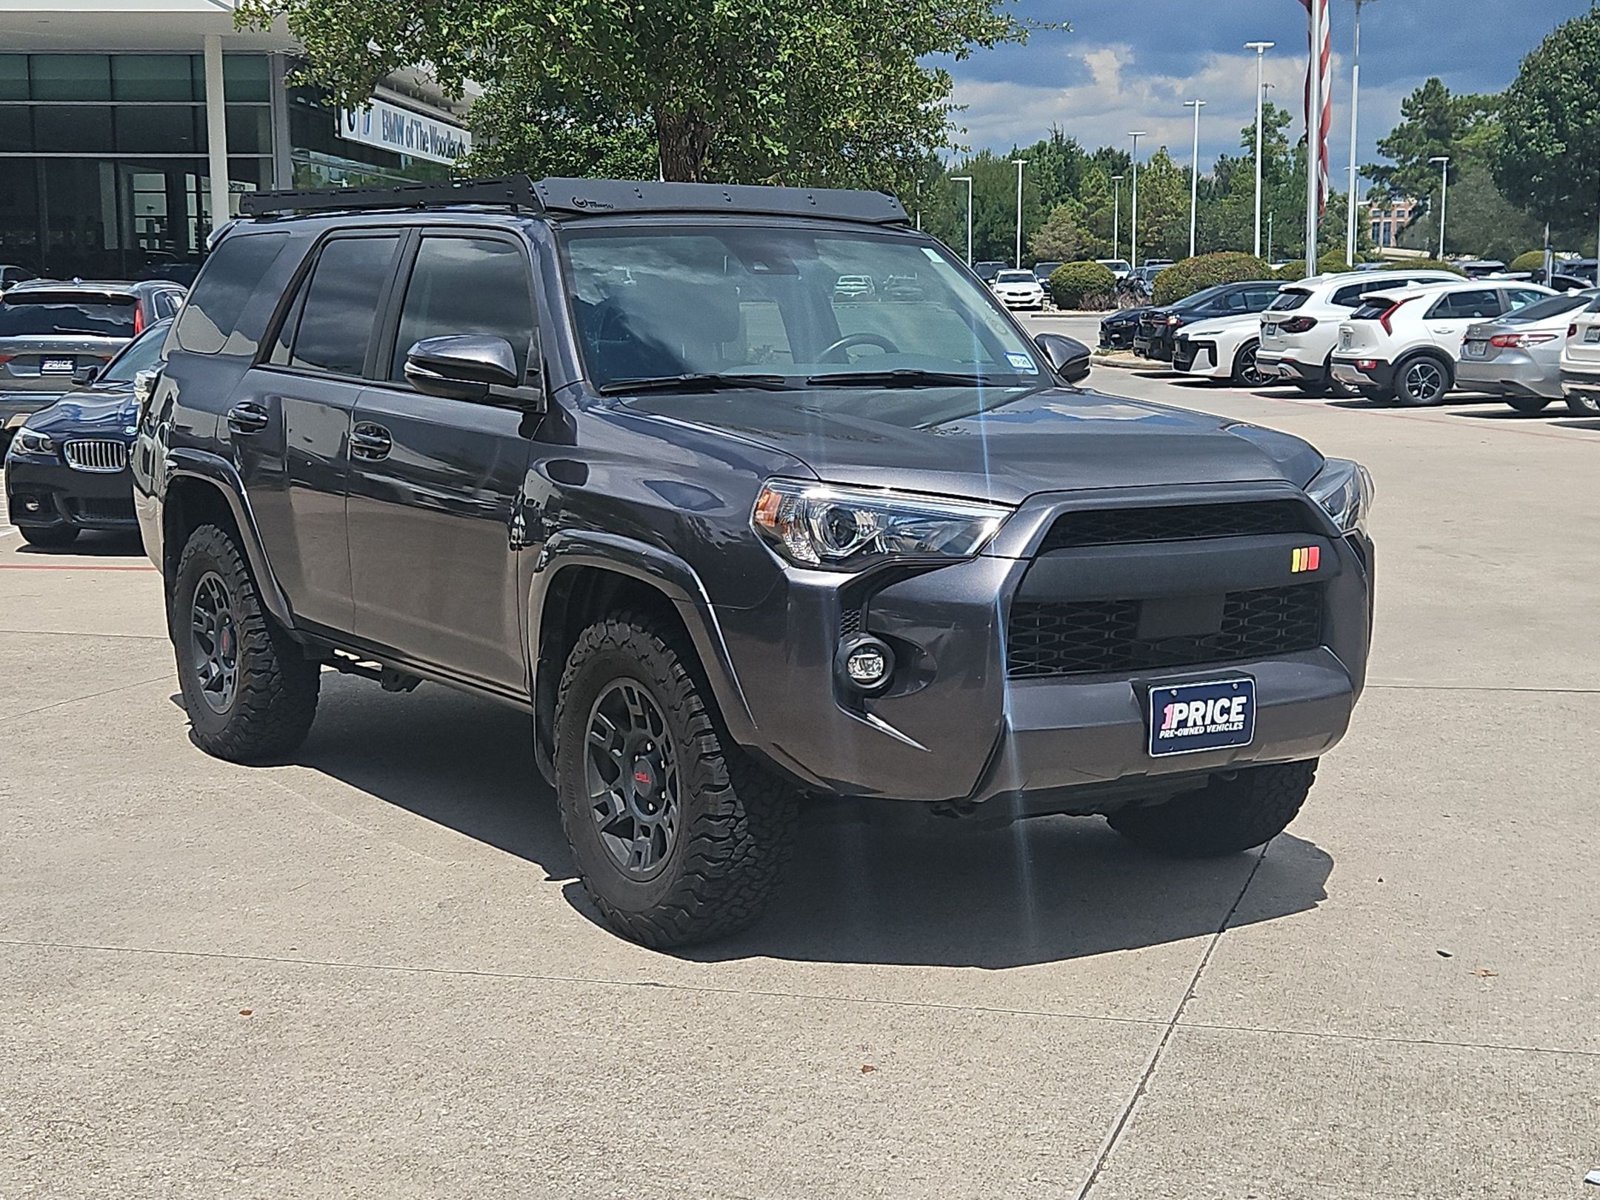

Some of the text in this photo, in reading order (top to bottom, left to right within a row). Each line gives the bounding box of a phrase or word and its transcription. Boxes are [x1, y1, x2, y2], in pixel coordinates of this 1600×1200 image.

[382, 108, 404, 146] BMW
[405, 118, 413, 149] of
[414, 120, 429, 153] The
[1159, 722, 1244, 739] PRE-OWNED VEHICLES
